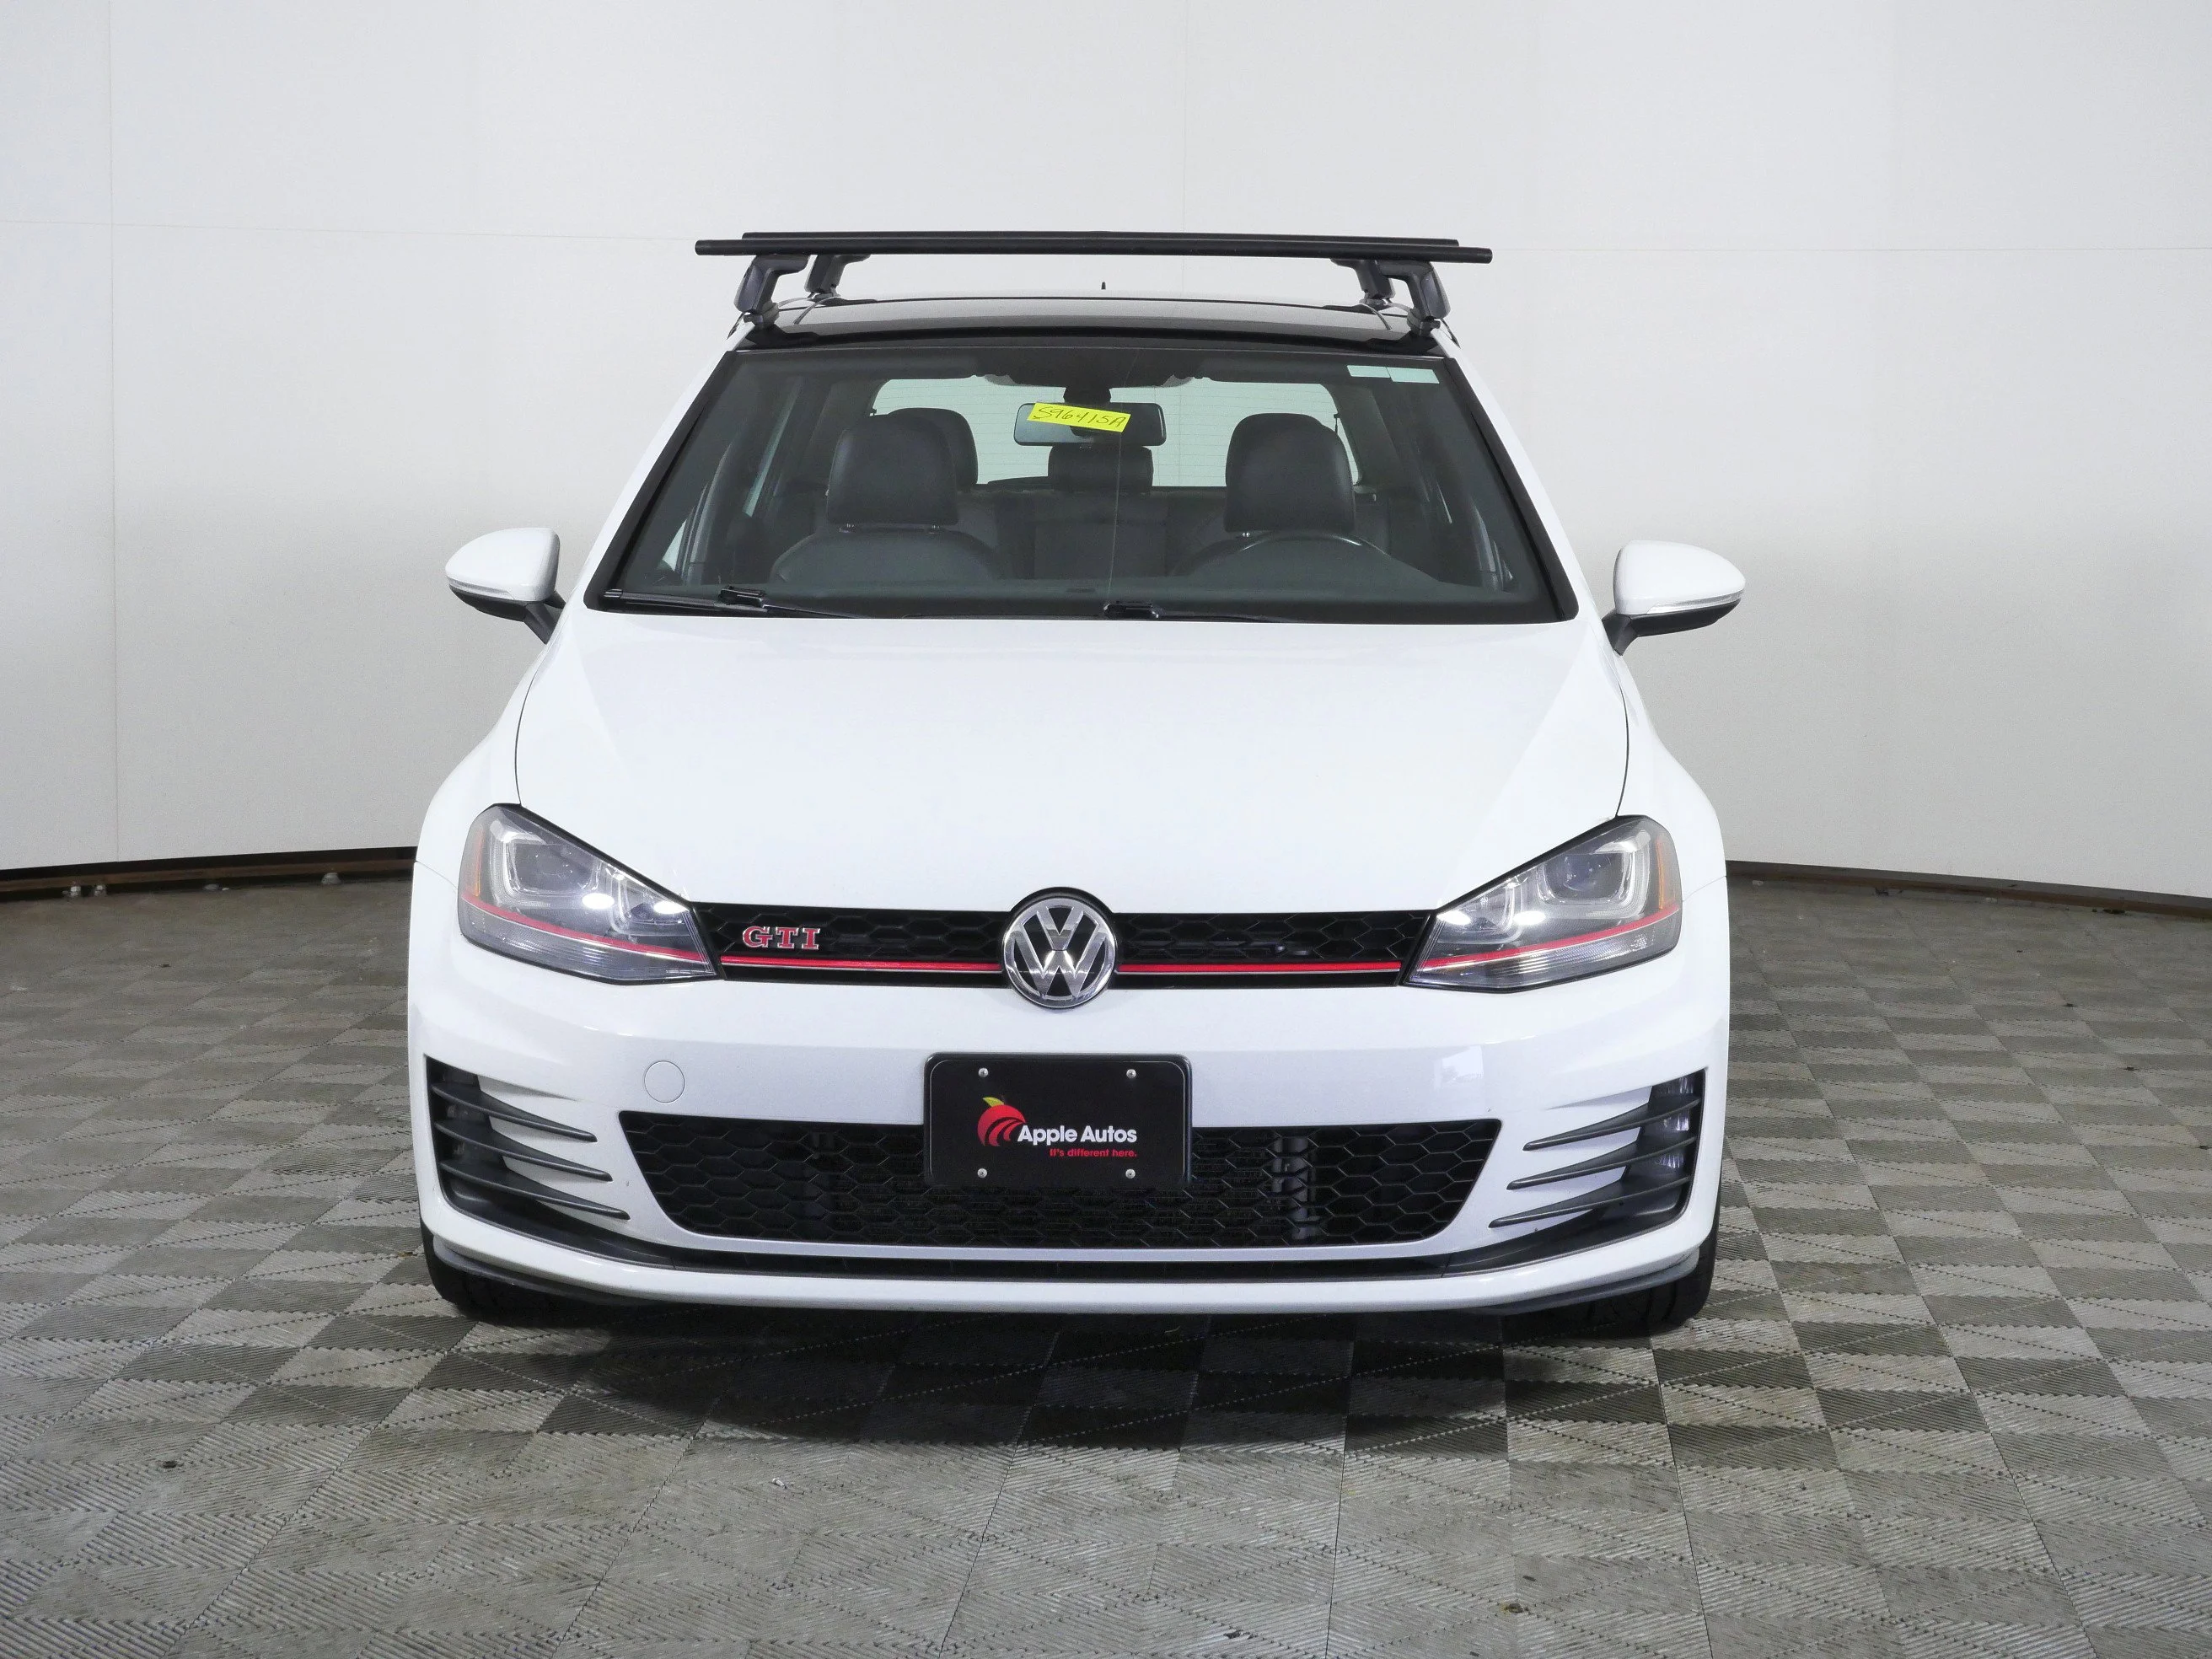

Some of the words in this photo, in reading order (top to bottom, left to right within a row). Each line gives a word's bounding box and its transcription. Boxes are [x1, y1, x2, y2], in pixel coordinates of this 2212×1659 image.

[742, 926, 821, 951] GTI
[1005, 899, 1114, 1007] VW
[1017, 1125, 1078, 1146] Apple
[1080, 1125, 1138, 1143] Autos
[1049, 1148, 1065, 1157] It's
[1066, 1148, 1109, 1157] different
[1111, 1148, 1138, 1157] here.
